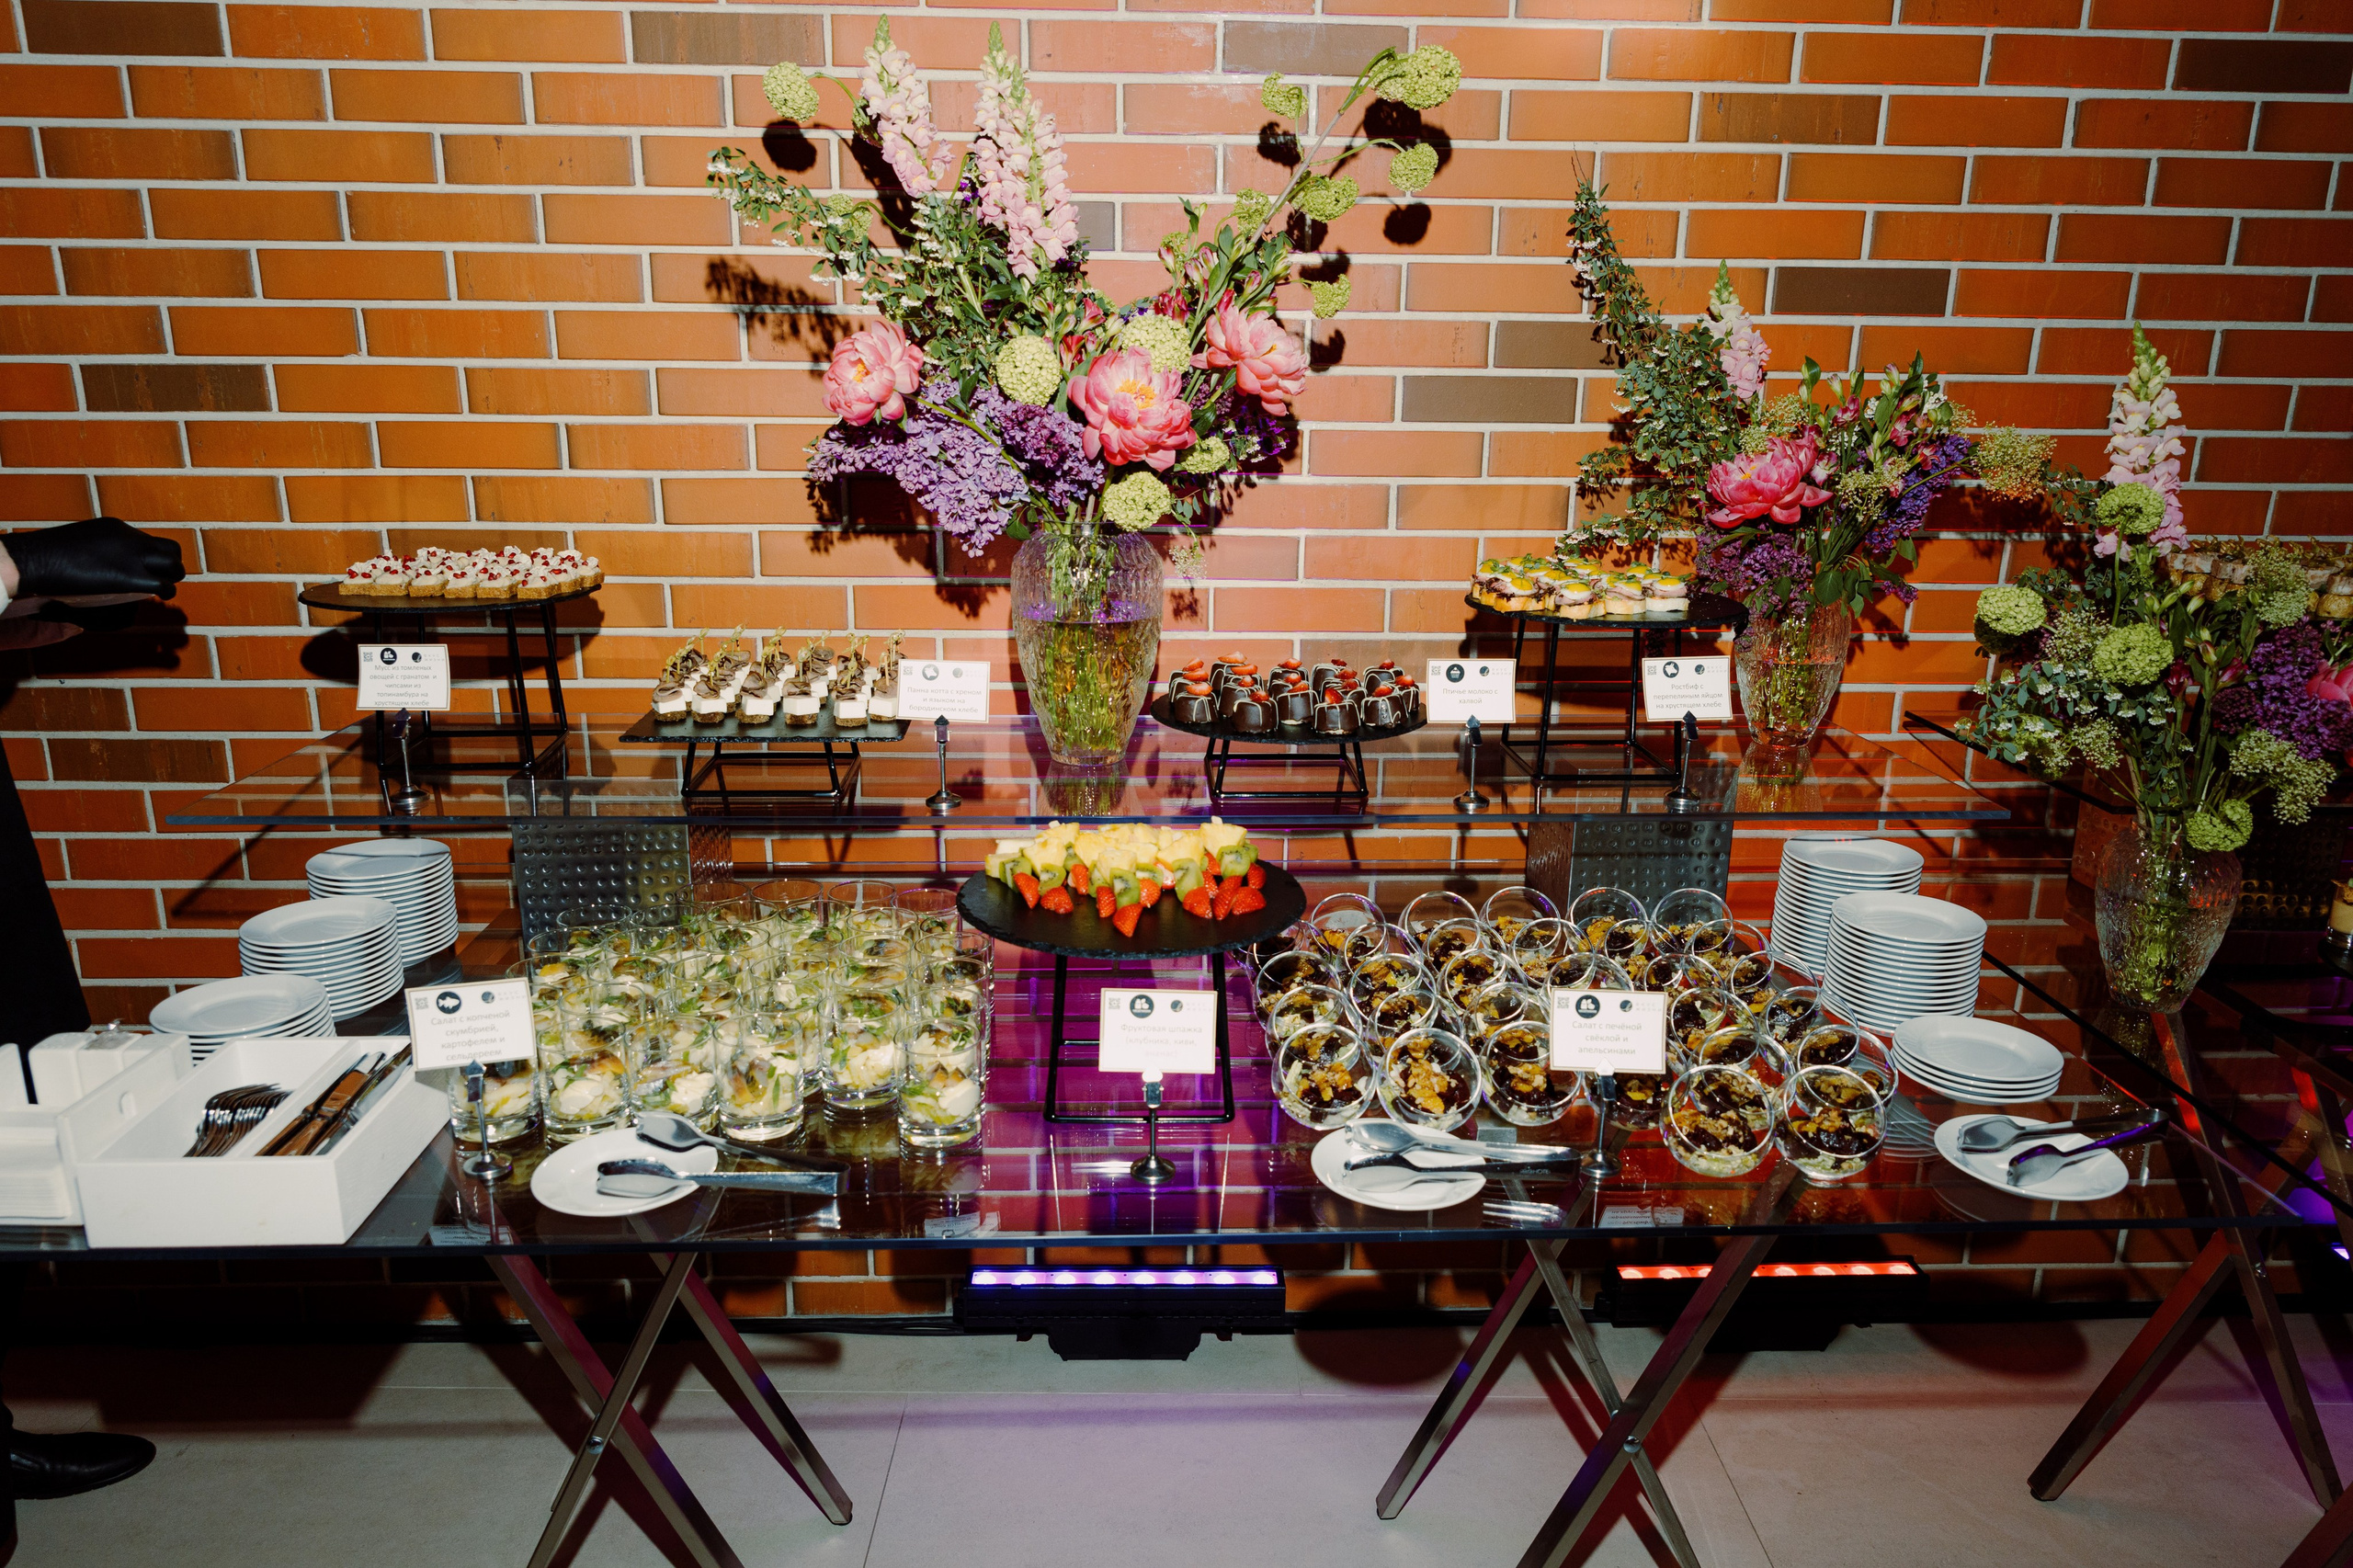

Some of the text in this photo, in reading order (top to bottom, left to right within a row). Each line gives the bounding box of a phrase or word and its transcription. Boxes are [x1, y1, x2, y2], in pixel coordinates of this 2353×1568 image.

[908, 704, 957, 712] бородинском
[1665, 701, 1701, 710] хрустящем
[430, 1017, 457, 1026] Салат
[466, 1010, 510, 1022] копченой
[1120, 1024, 1166, 1033] Фруктовая
[1605, 1022, 1643, 1030] печёной
[446, 1025, 499, 1037] скумбрией,
[1125, 1036, 1172, 1045] (клубника,
[1585, 1034, 1620, 1042] свёклой
[441, 1038, 497, 1050] картофелем
[446, 1049, 503, 1061] сельдереем
